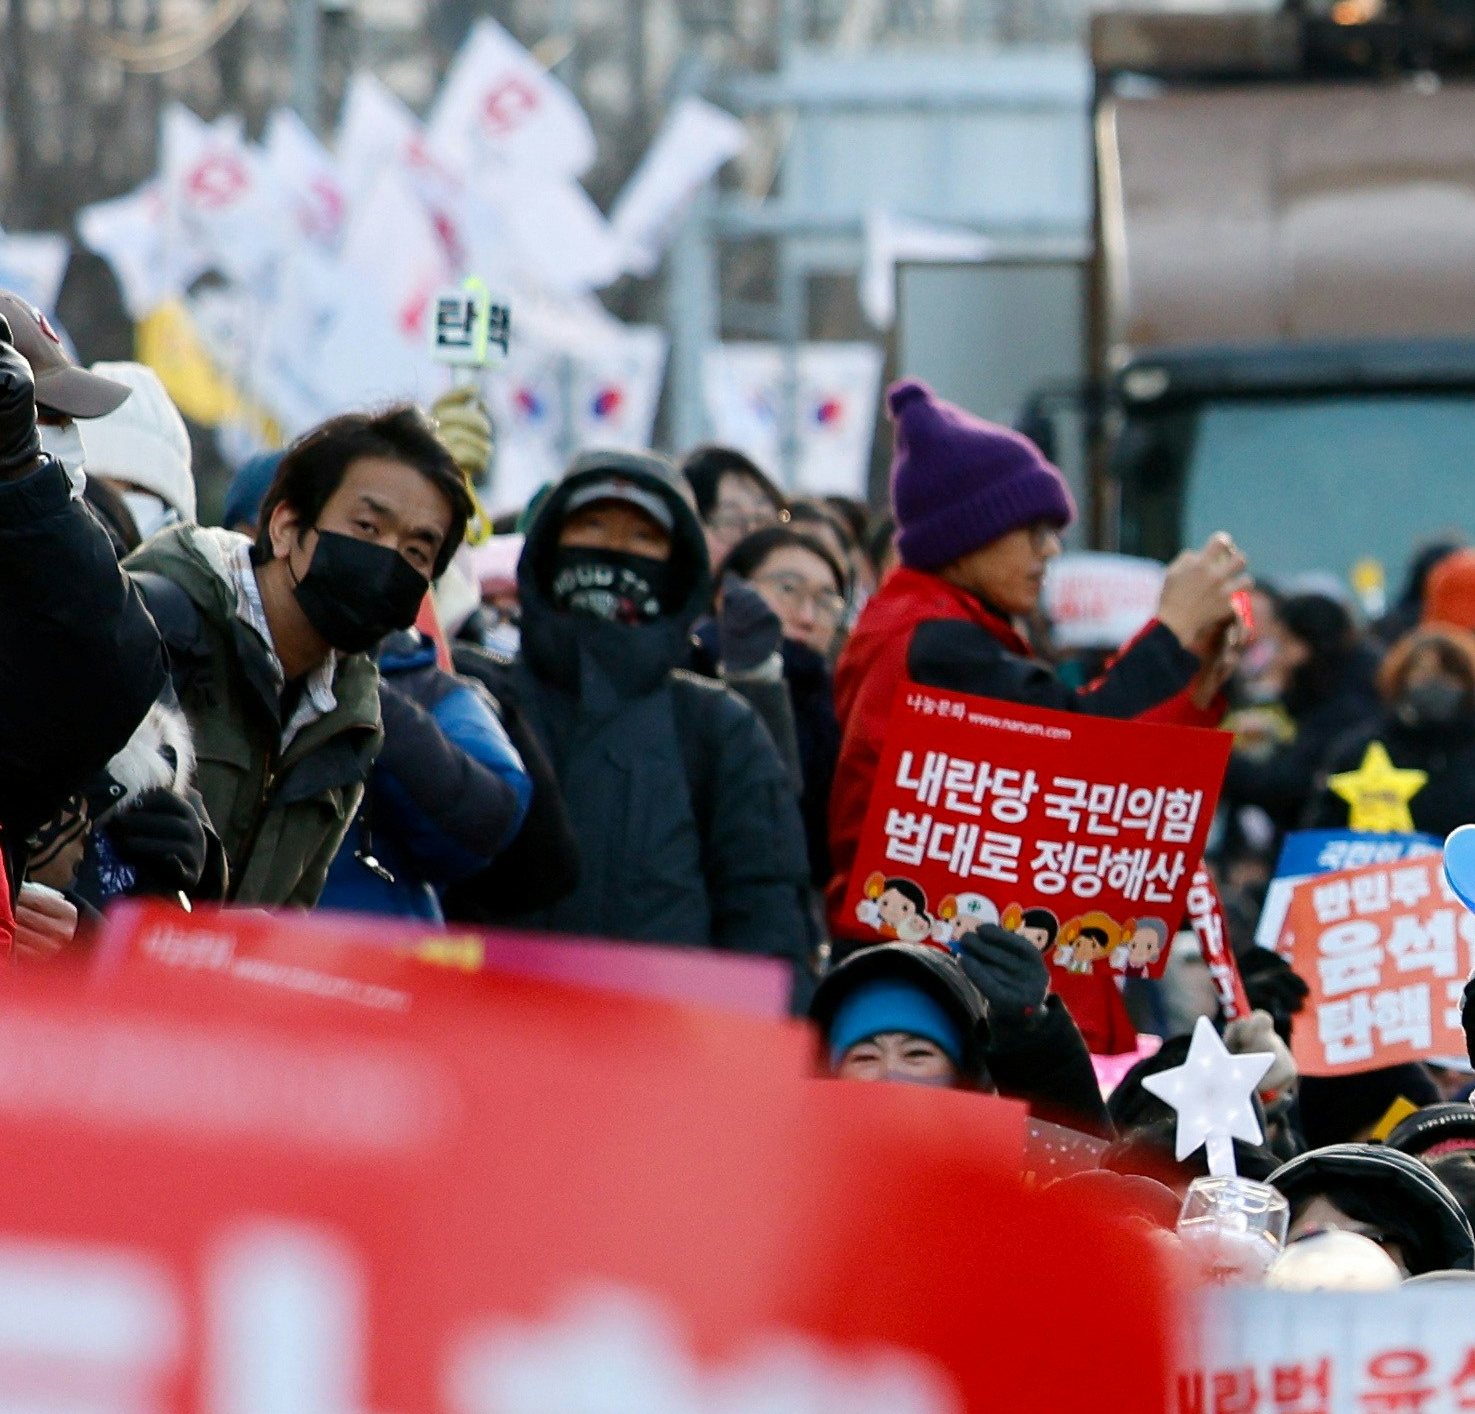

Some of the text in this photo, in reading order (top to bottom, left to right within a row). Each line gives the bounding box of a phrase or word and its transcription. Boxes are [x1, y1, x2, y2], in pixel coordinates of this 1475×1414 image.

[894, 749, 1203, 844] 내란당 국민의힘
[883, 807, 1187, 904] 법대로 정당해산
[1316, 984, 1433, 1066] 탄핵
